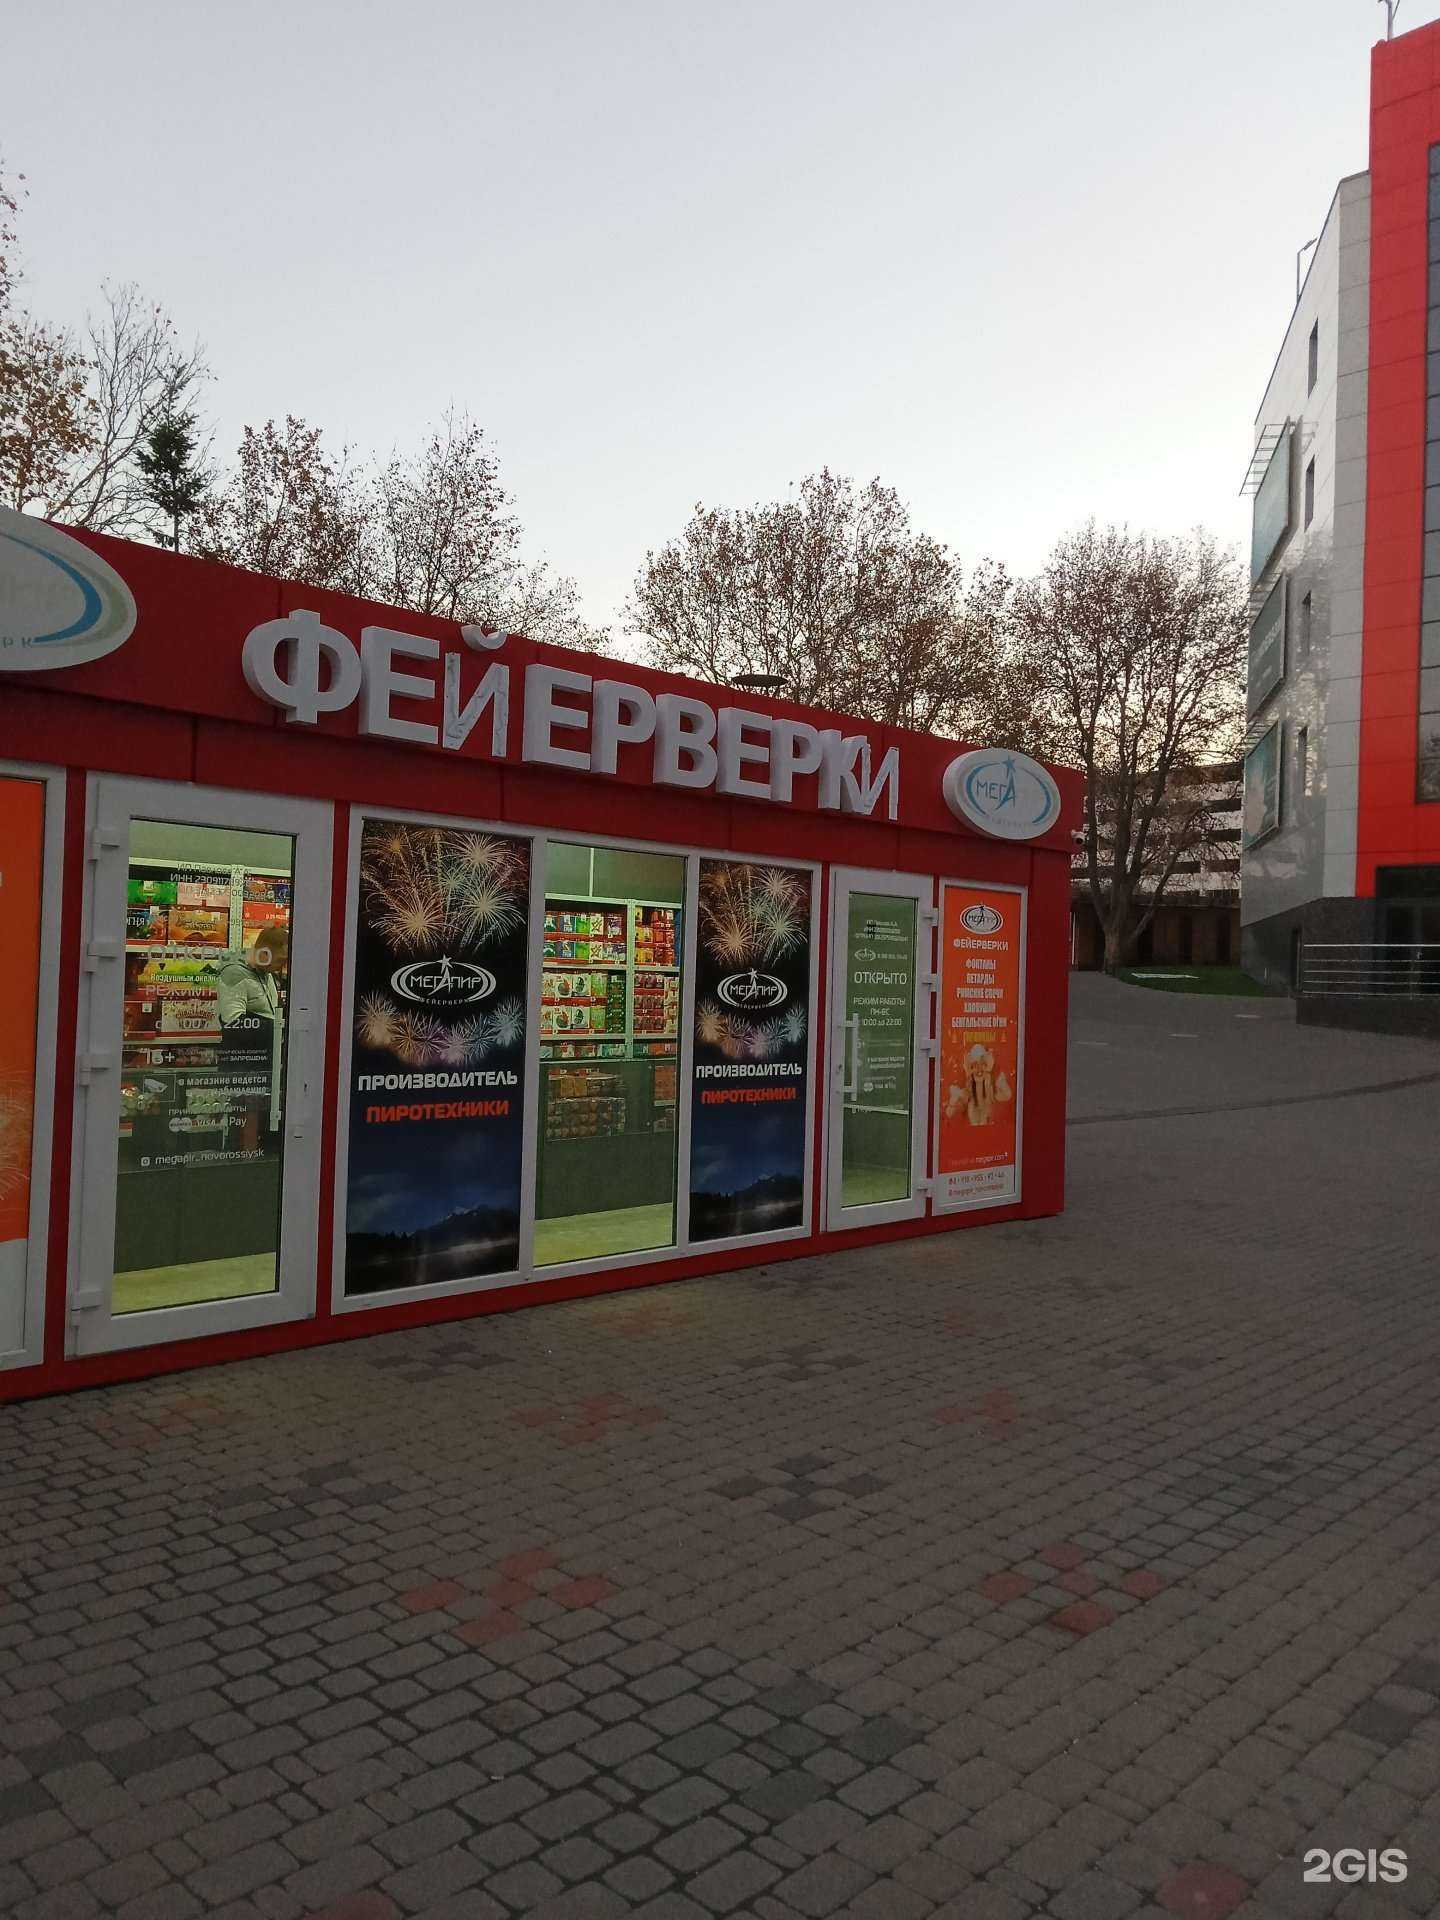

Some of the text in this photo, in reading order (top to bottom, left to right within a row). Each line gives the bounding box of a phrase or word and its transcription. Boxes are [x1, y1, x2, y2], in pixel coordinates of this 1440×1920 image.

[242, 608, 900, 820] ФЕЙЕРВЕРКИ
[170, 872, 193, 883] ИНН
[953, 937, 1009, 951] ФЕЙЕРВЕРКИ
[854, 971, 908, 985] ОТКРЫТО
[224, 1017, 261, 1029] 22:00
[696, 1063, 803, 1079] ПРОИЗВОДИТЕЛЬ
[358, 1070, 518, 1092] ПРОИЗВОДИТЕЛЬ
[701, 1088, 797, 1105] ПИРОТЕХНИКИ
[366, 1100, 510, 1123] ПИРОТЕХНИКИ
[229, 1116, 247, 1128] Pay
